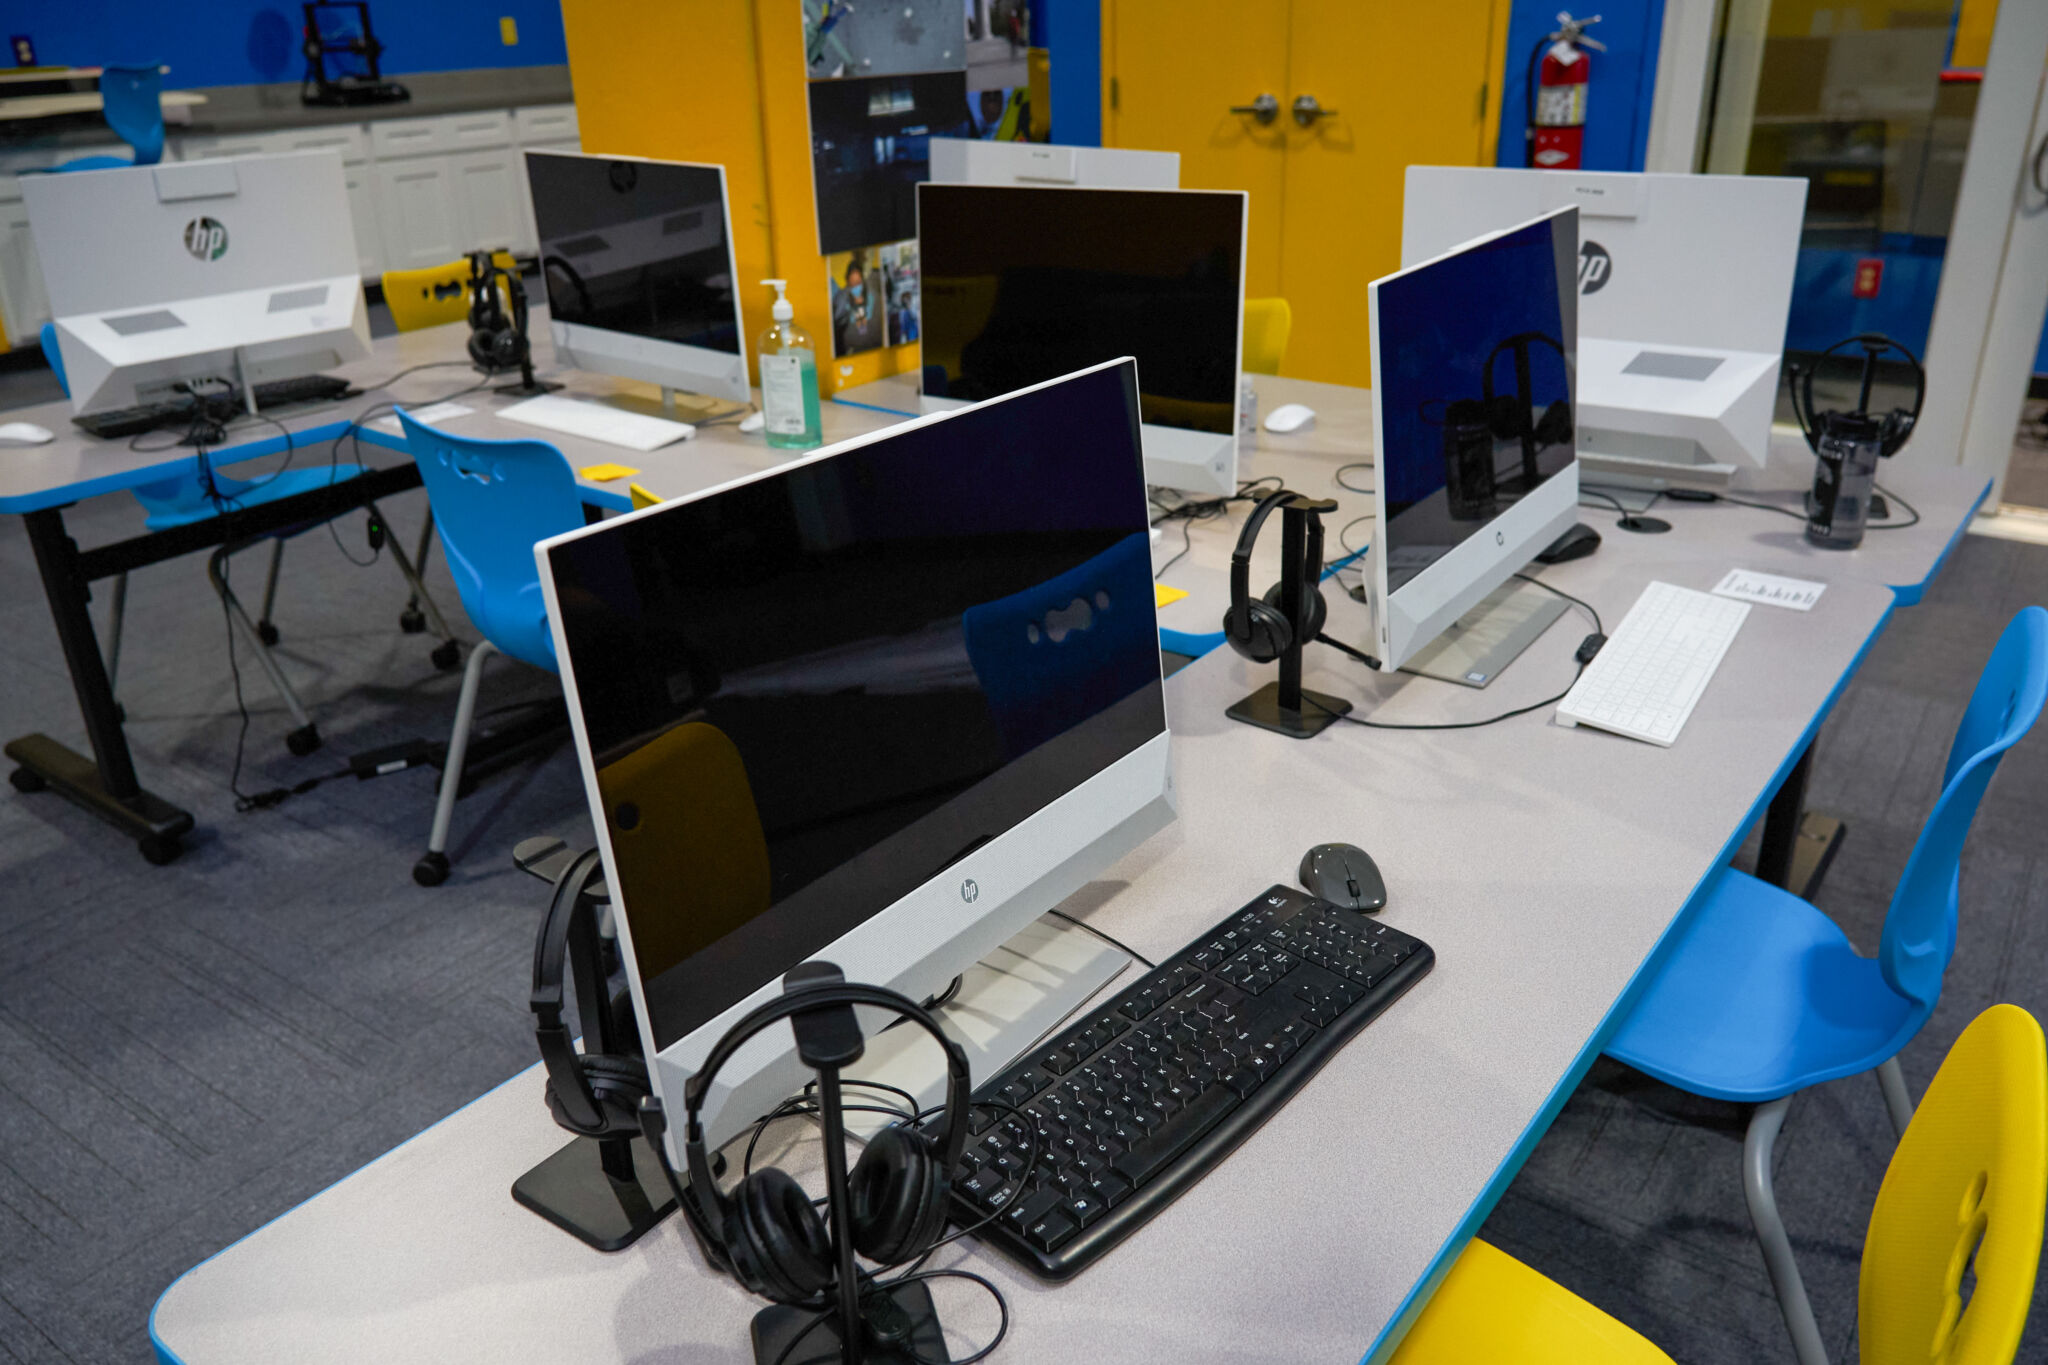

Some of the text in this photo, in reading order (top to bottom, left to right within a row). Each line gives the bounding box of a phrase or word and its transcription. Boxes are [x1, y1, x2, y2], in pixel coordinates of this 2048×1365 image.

[188, 216, 225, 262] hp
[962, 880, 978, 903] hp
[966, 1178, 979, 1186] Tab
[1034, 1224, 1046, 1233] Ctrl
